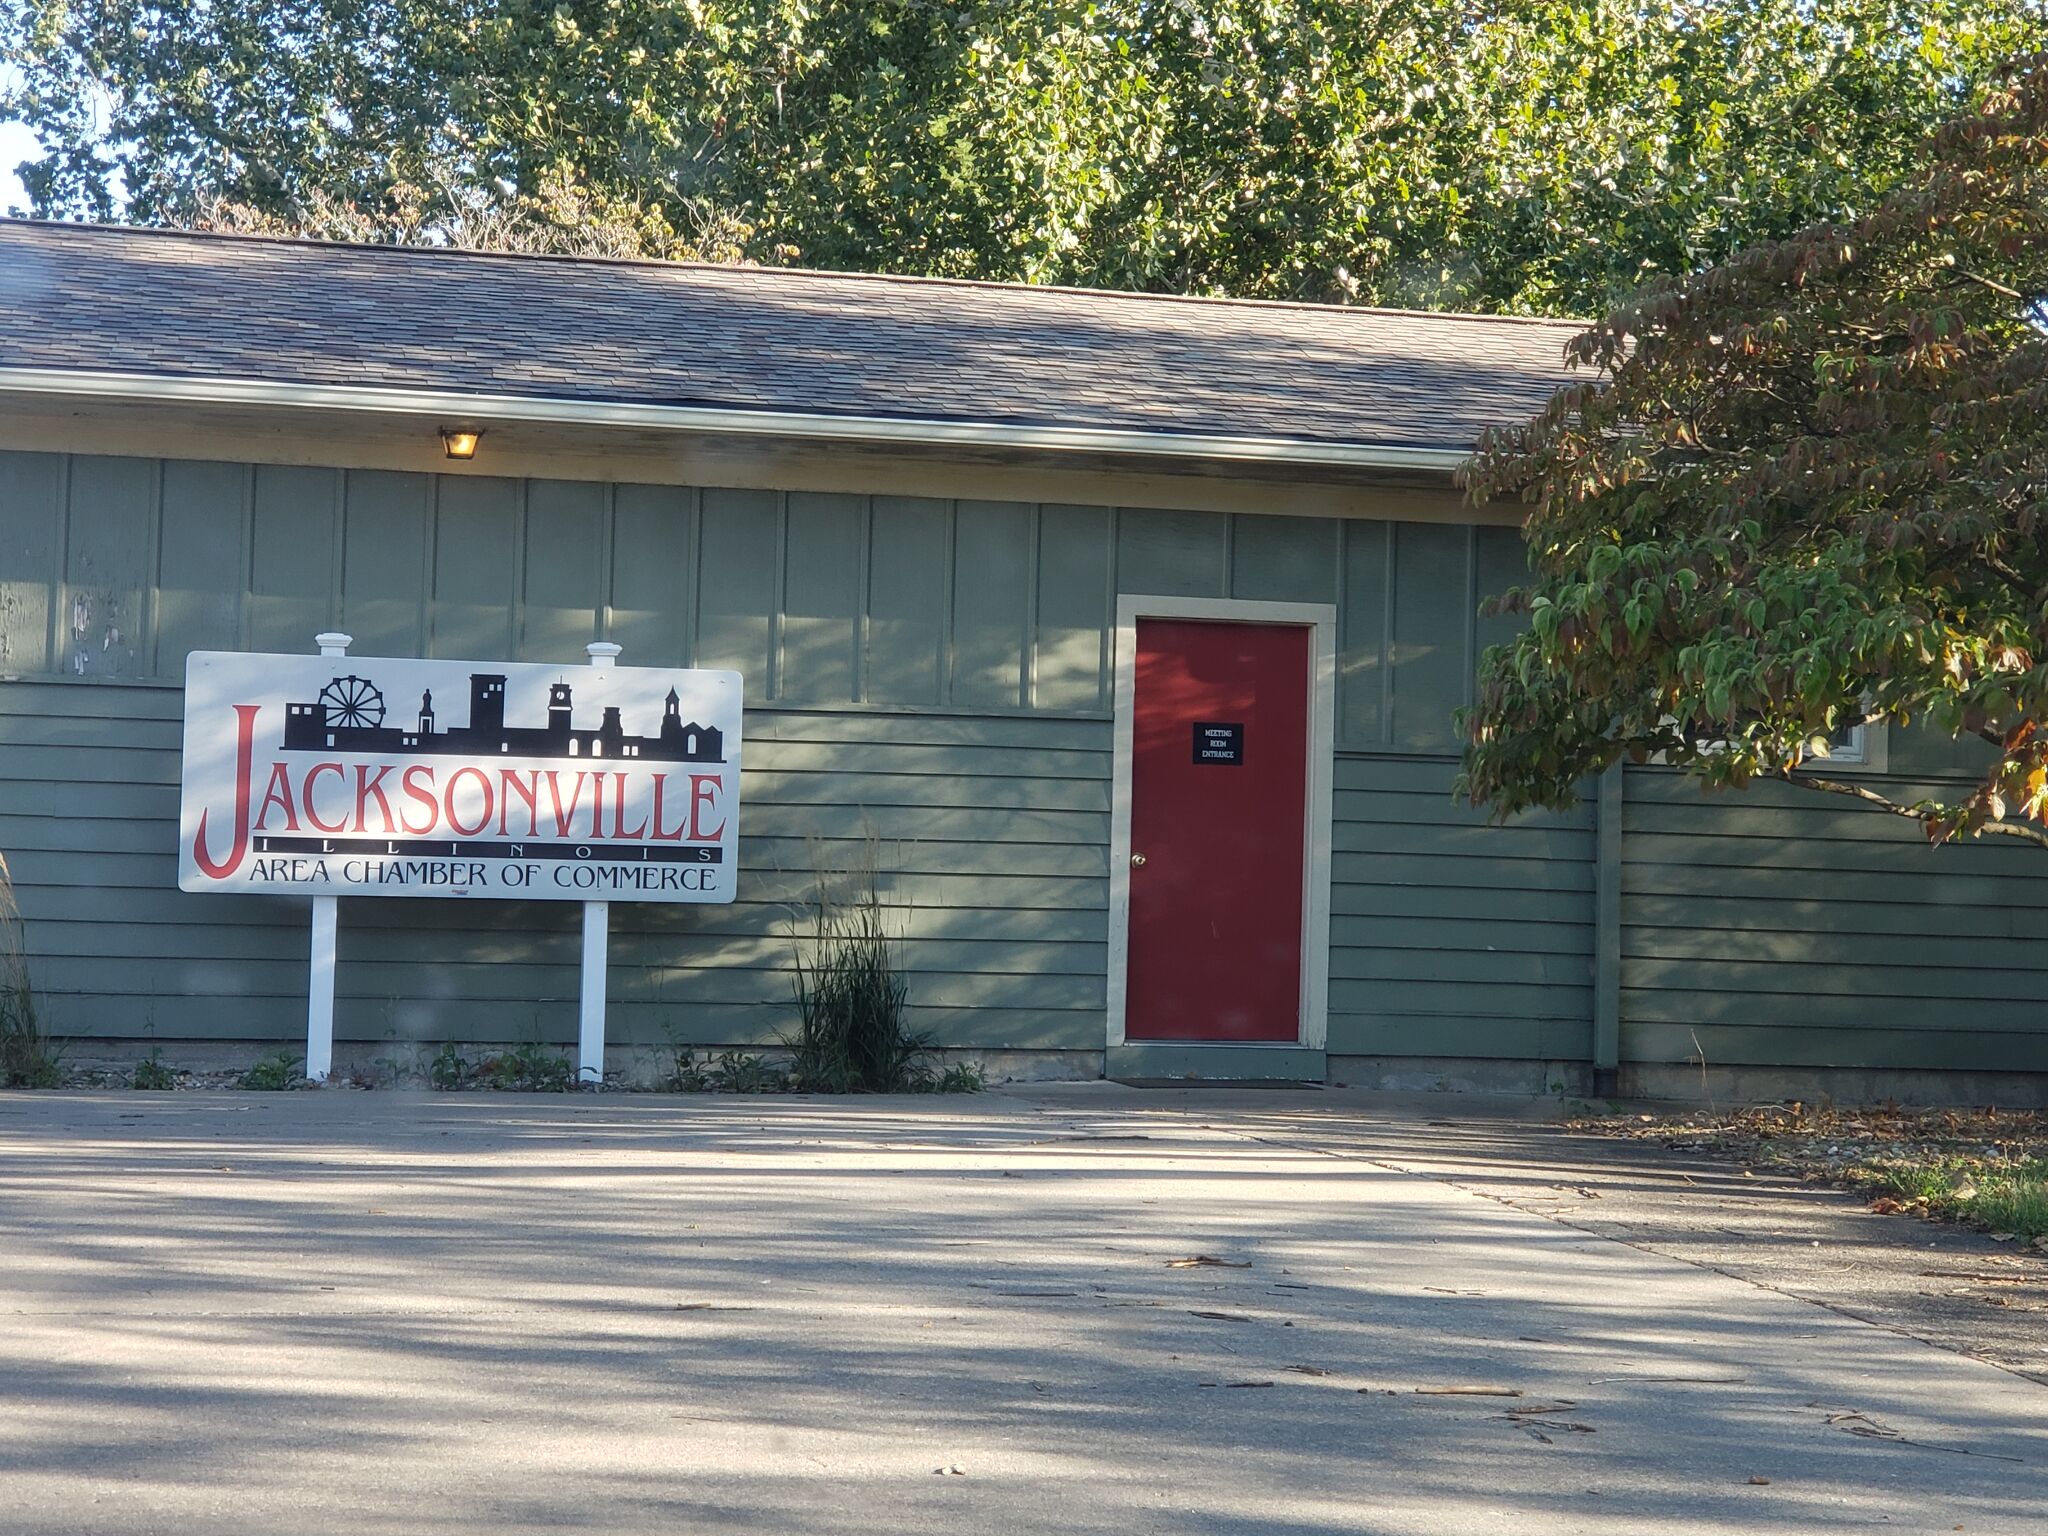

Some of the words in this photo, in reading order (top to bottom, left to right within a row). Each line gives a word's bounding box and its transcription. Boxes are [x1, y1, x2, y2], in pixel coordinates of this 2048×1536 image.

[1205, 729, 1232, 737] MEETING
[1210, 740, 1226, 748] ROOM
[1202, 750, 1234, 758] ENTRANCE
[193, 704, 727, 879] JACKSONVILLE
[262, 838, 712, 861] ILLINOIS
[249, 858, 330, 883] AREA
[343, 860, 488, 886] CHAMBER
[501, 864, 541, 887] OF
[553, 865, 717, 891] COMMERCE
